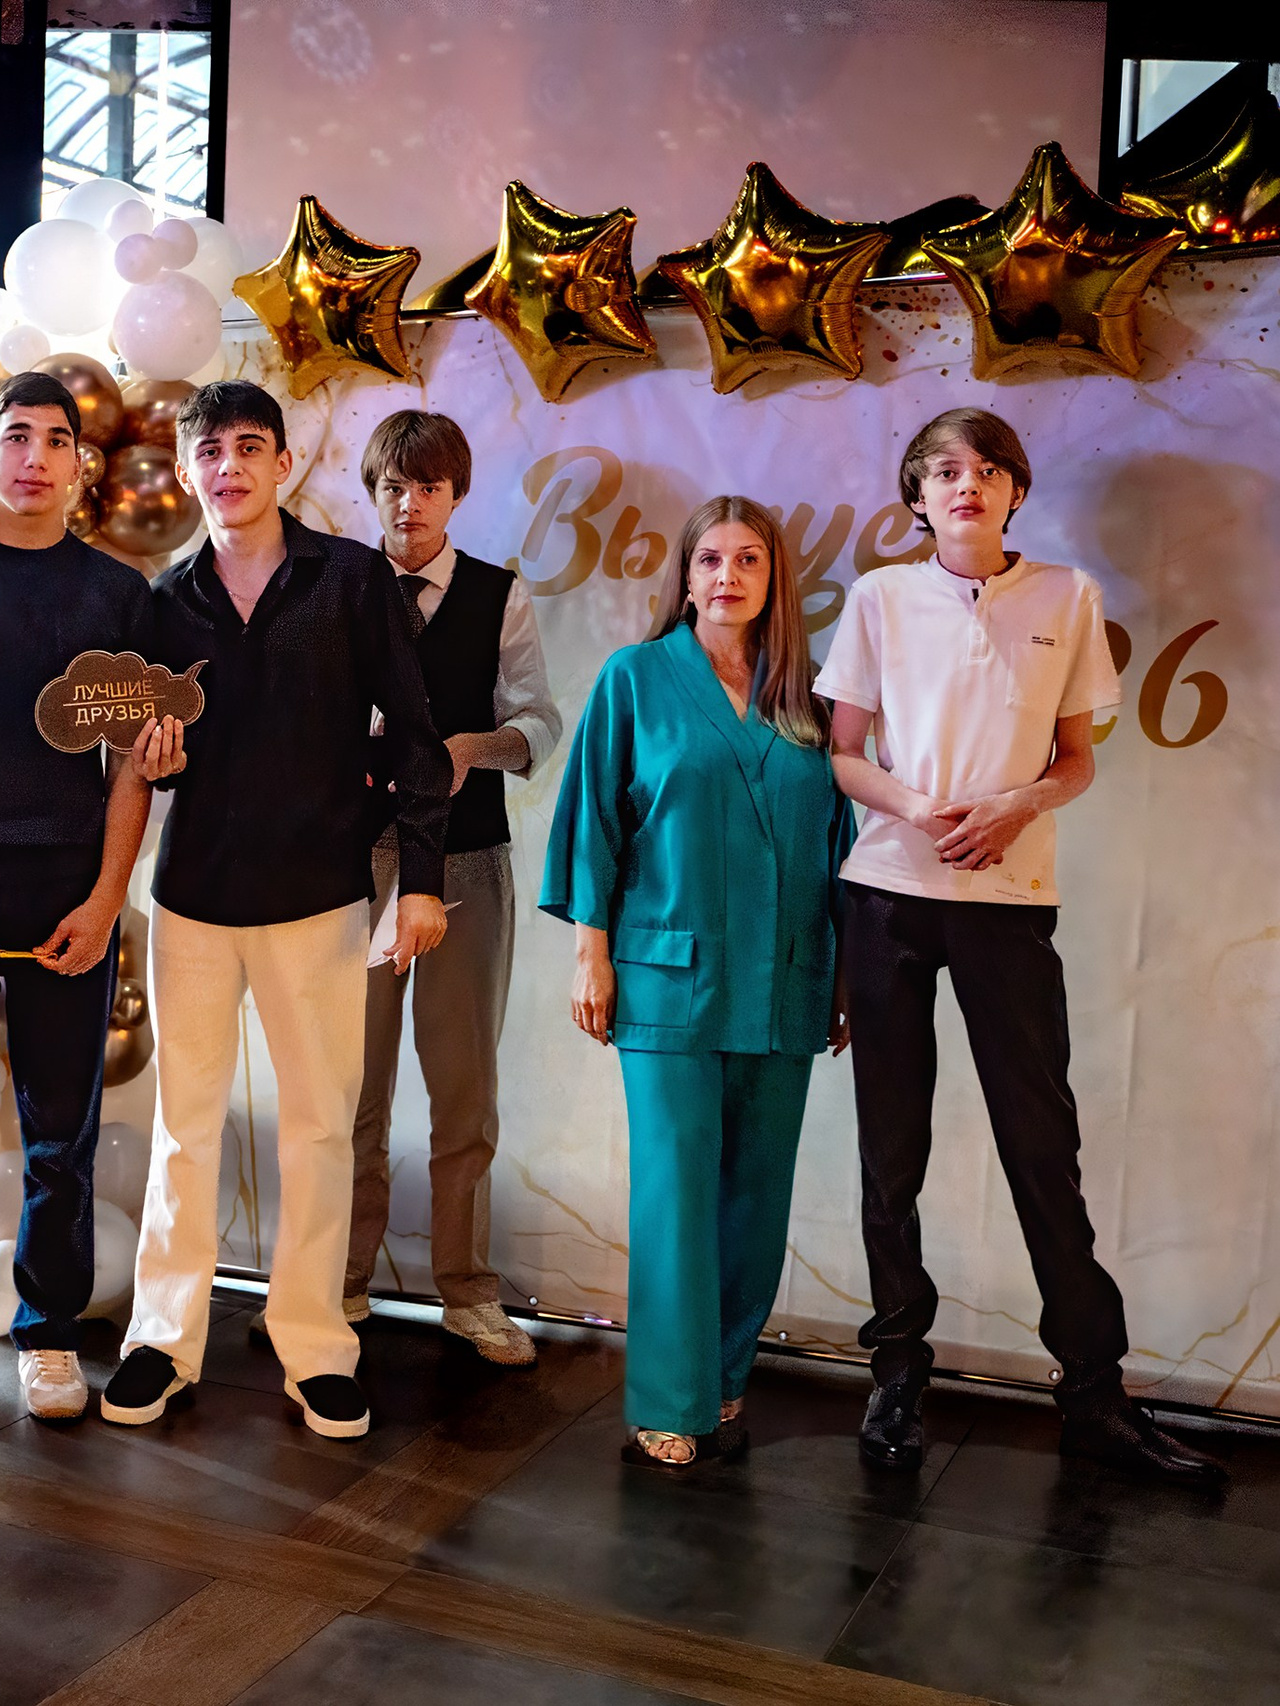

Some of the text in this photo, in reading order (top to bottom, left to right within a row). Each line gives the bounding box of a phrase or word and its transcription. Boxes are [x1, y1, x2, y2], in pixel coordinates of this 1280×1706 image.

[505, 445, 937, 635] Выус
[73, 679, 155, 701] ЛУЧШИЕ
[75, 702, 156, 727] ДРУЗЬЯ
